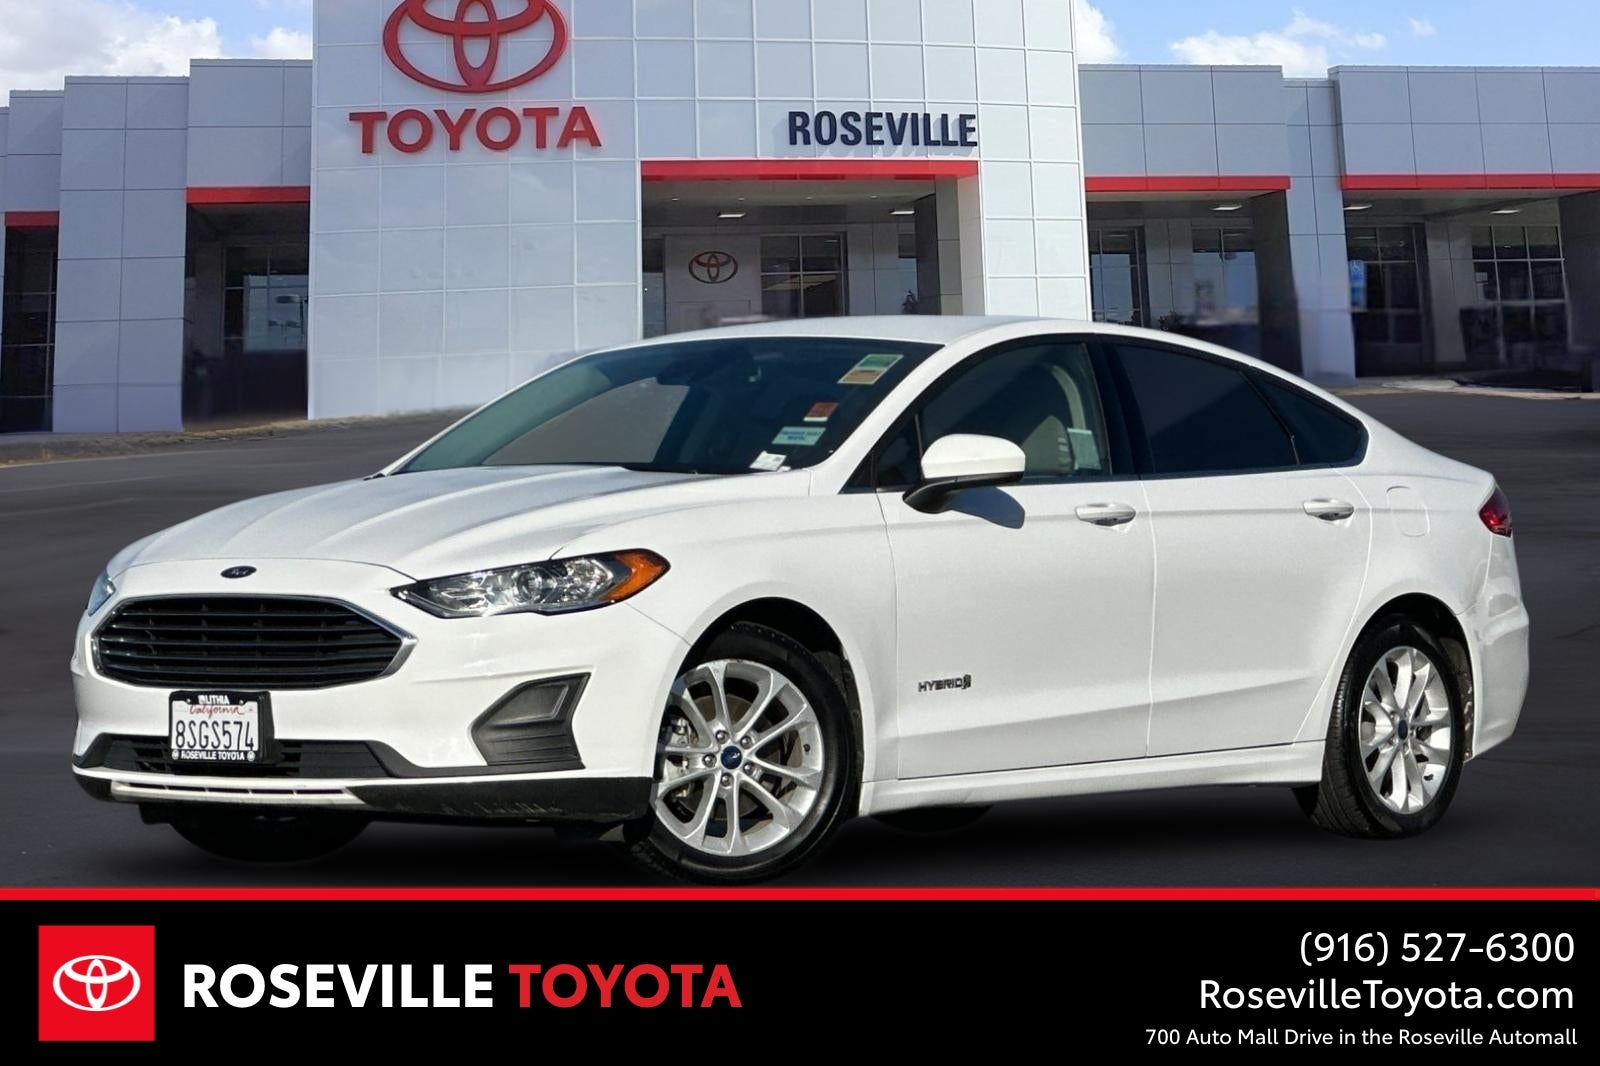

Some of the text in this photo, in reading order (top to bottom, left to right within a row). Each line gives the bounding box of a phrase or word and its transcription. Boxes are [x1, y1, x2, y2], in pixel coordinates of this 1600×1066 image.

[349, 106, 602, 154] TOYOTA
[788, 110, 978, 148] ROSEVILLE
[918, 677, 962, 692] HYBRID
[175, 719, 254, 751] 8SGS574
[181, 750, 245, 760] ROSEVILLE TOYOTA
